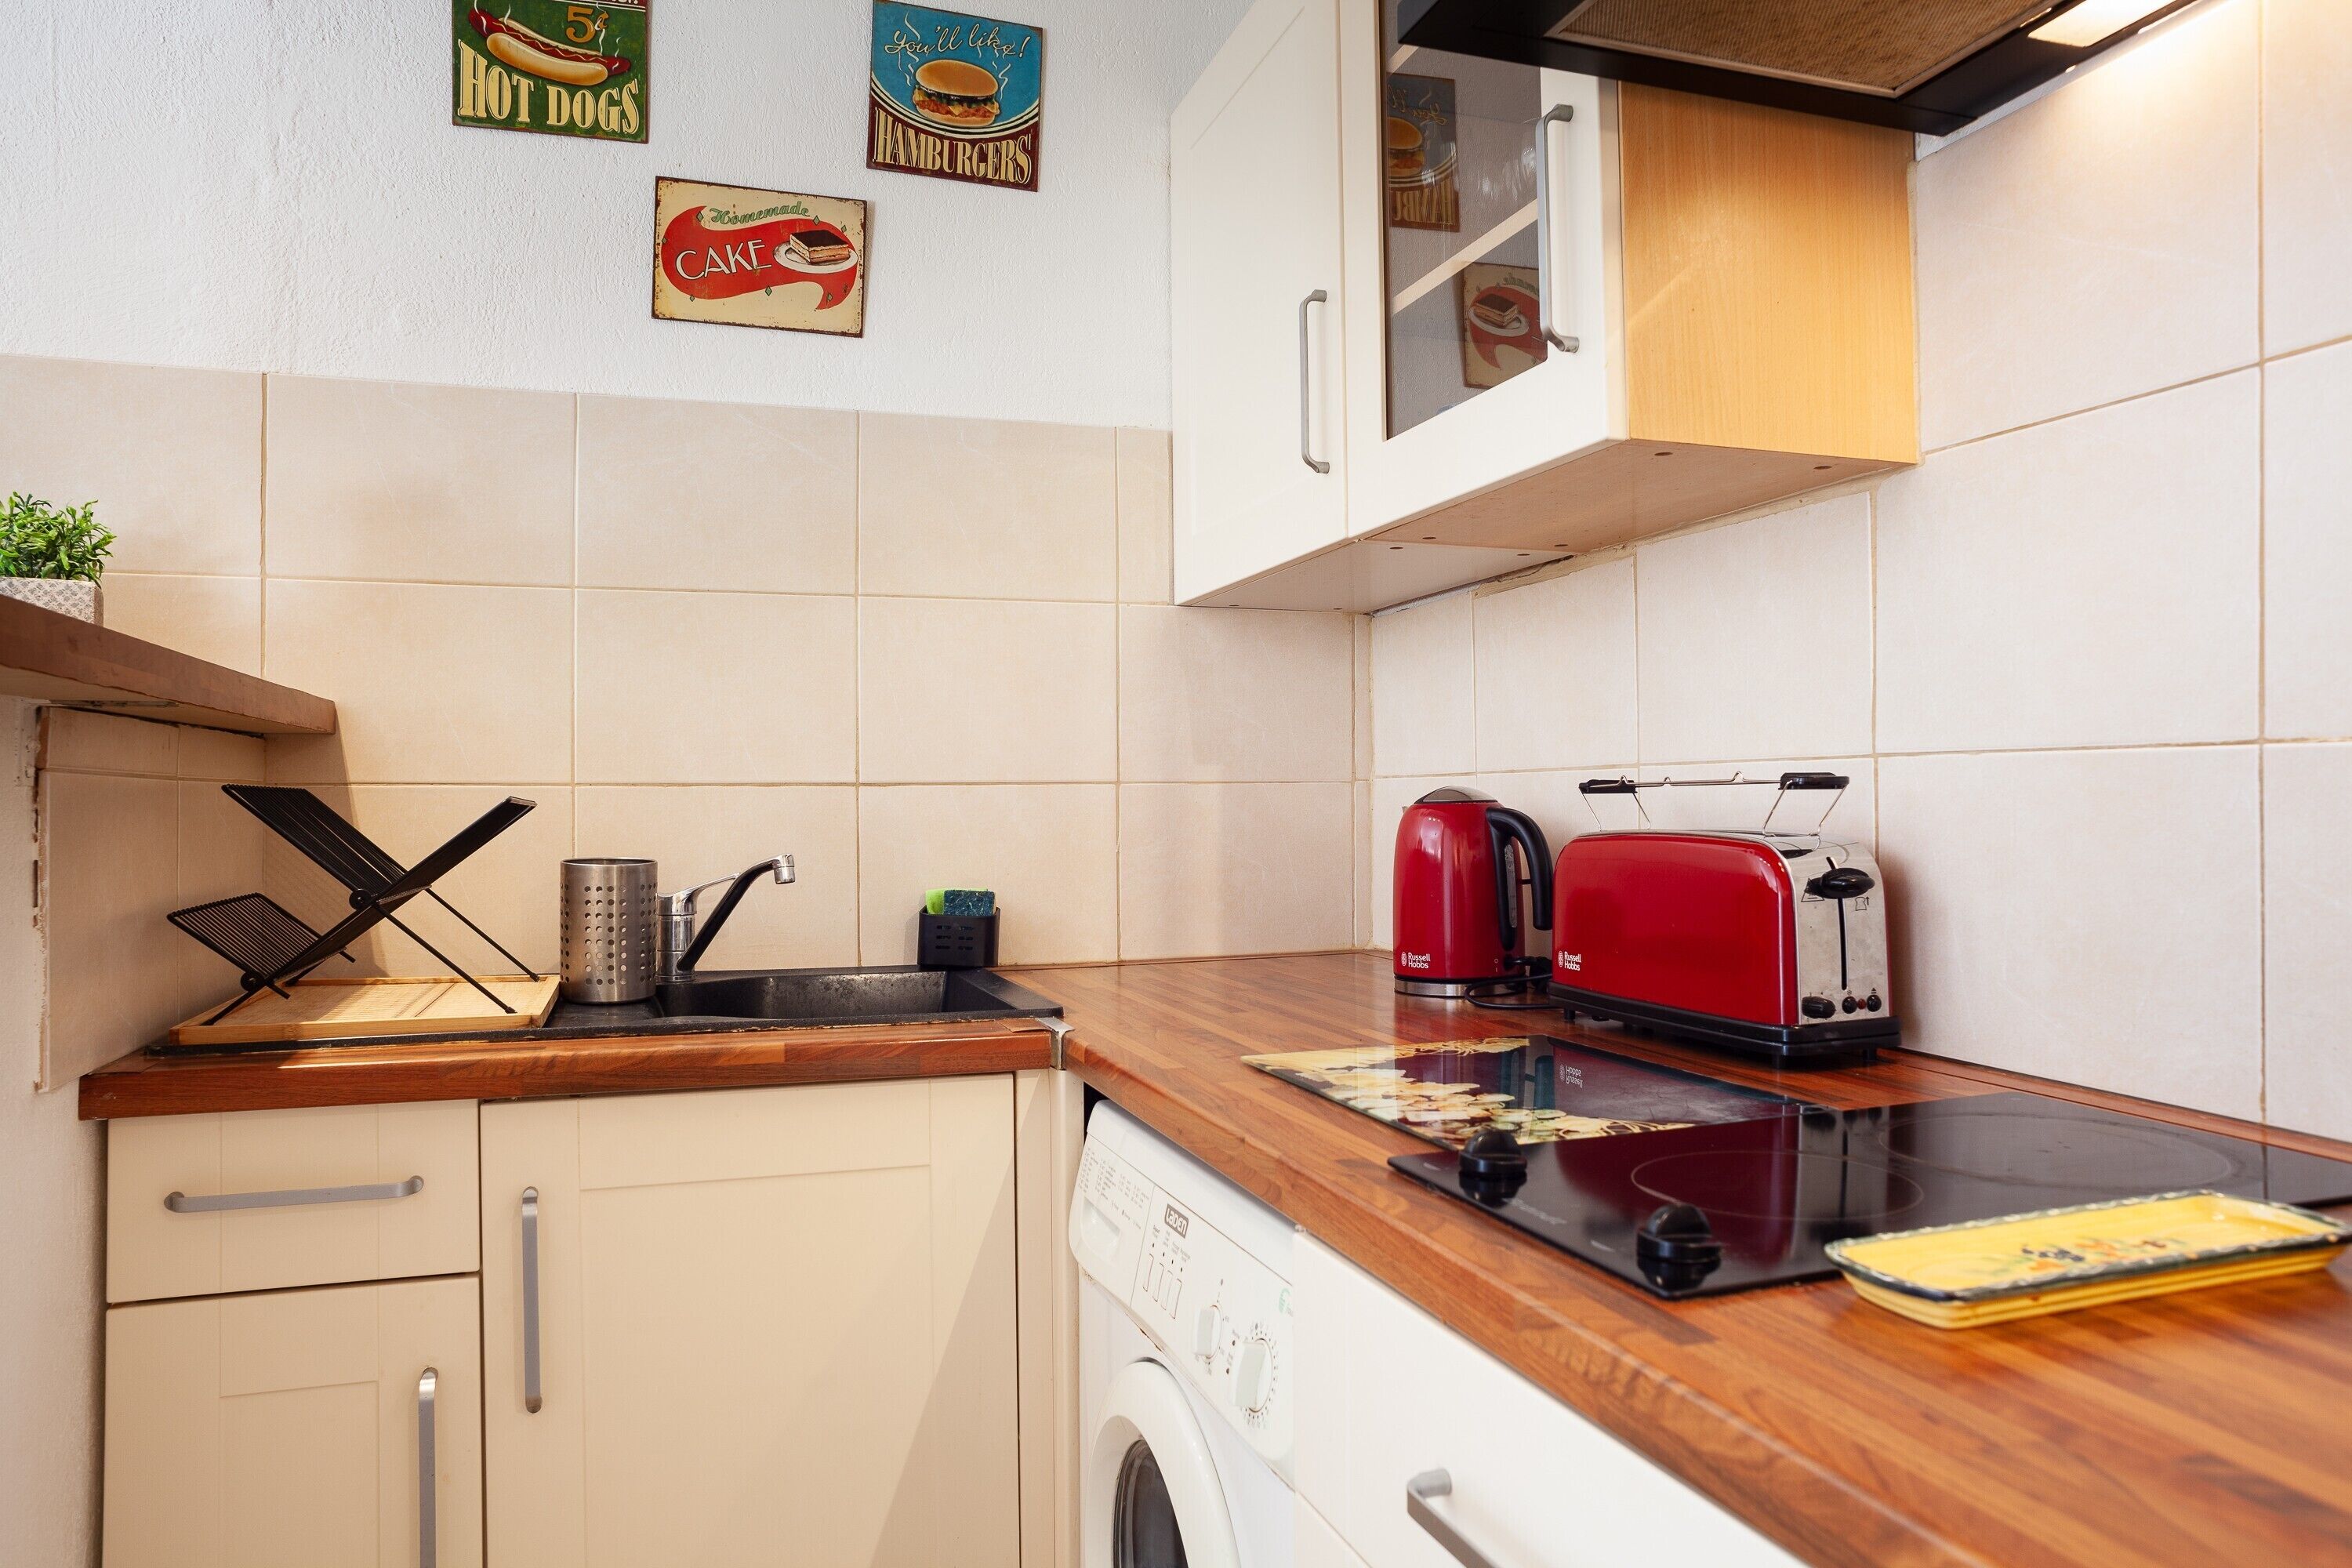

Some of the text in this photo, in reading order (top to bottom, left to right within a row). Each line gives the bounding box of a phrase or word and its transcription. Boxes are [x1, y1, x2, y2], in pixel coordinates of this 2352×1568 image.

[884, 24, 1031, 57] You'll like!
[458, 38, 640, 134] HOT DOGS
[873, 107, 1032, 184] HAMBURGERS
[710, 201, 811, 225] Homemade
[676, 239, 772, 280] CAKE
[1408, 952, 1431, 962] Russell
[1408, 960, 1429, 969] Hobbs
[1564, 951, 1582, 963] Russell
[1564, 960, 1581, 971] Hobbs
